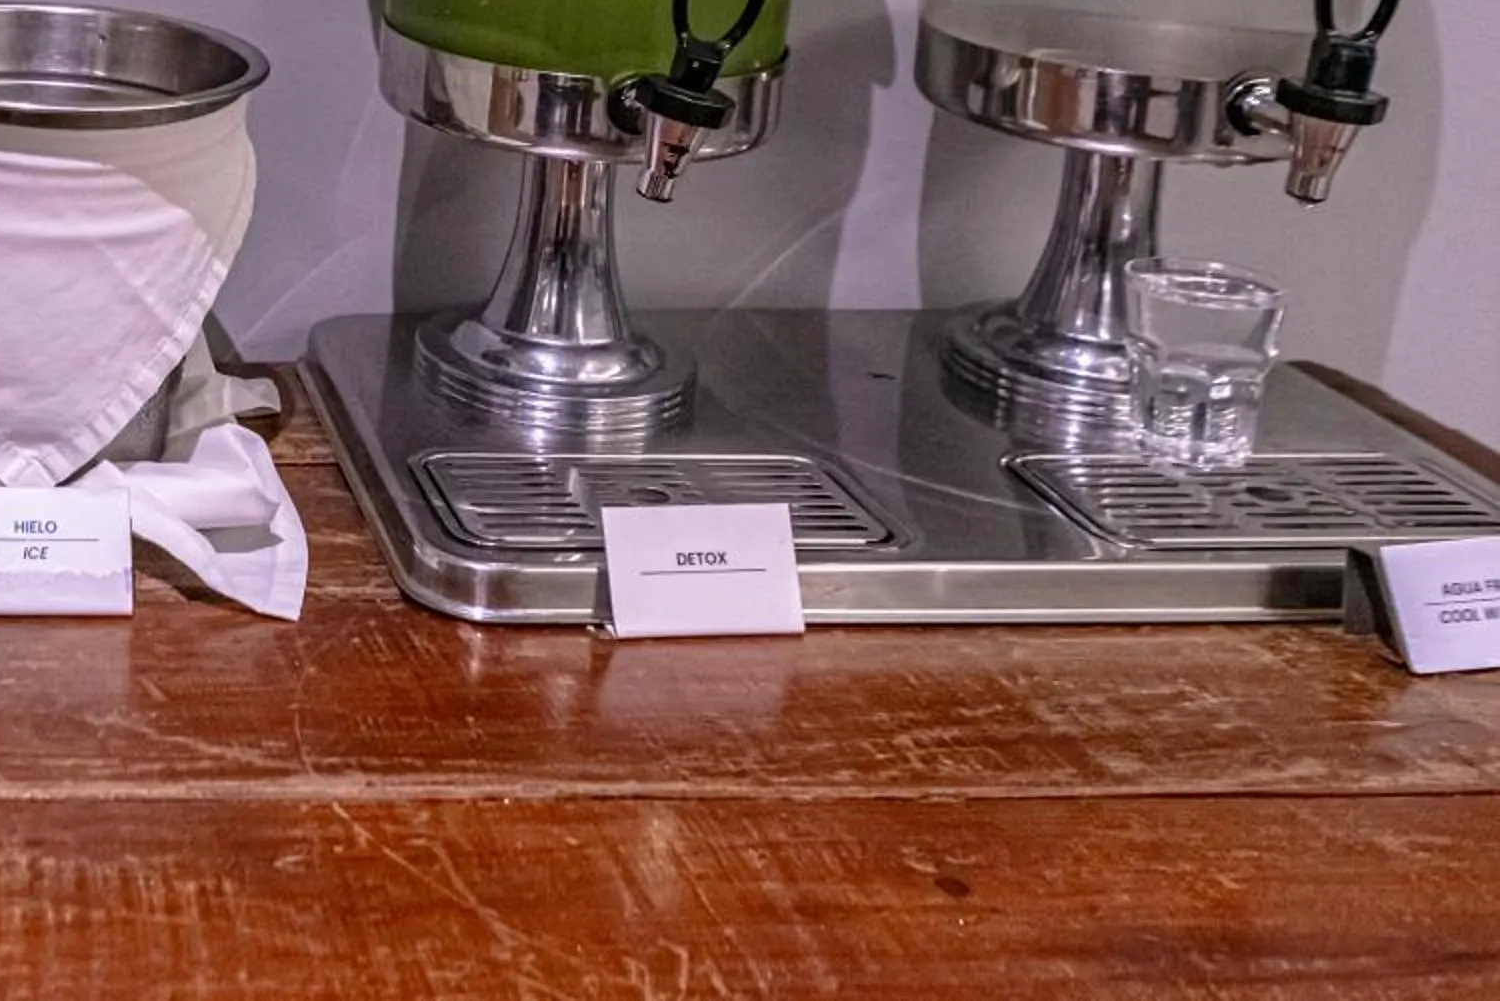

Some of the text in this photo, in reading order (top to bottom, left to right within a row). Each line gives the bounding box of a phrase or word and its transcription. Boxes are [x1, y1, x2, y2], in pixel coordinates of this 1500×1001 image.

[13, 520, 57, 534] HIELO
[23, 546, 49, 560] ICE
[675, 552, 728, 566] DETOX
[1443, 581, 1482, 596] AGUA
[1440, 608, 1481, 624] COOL
